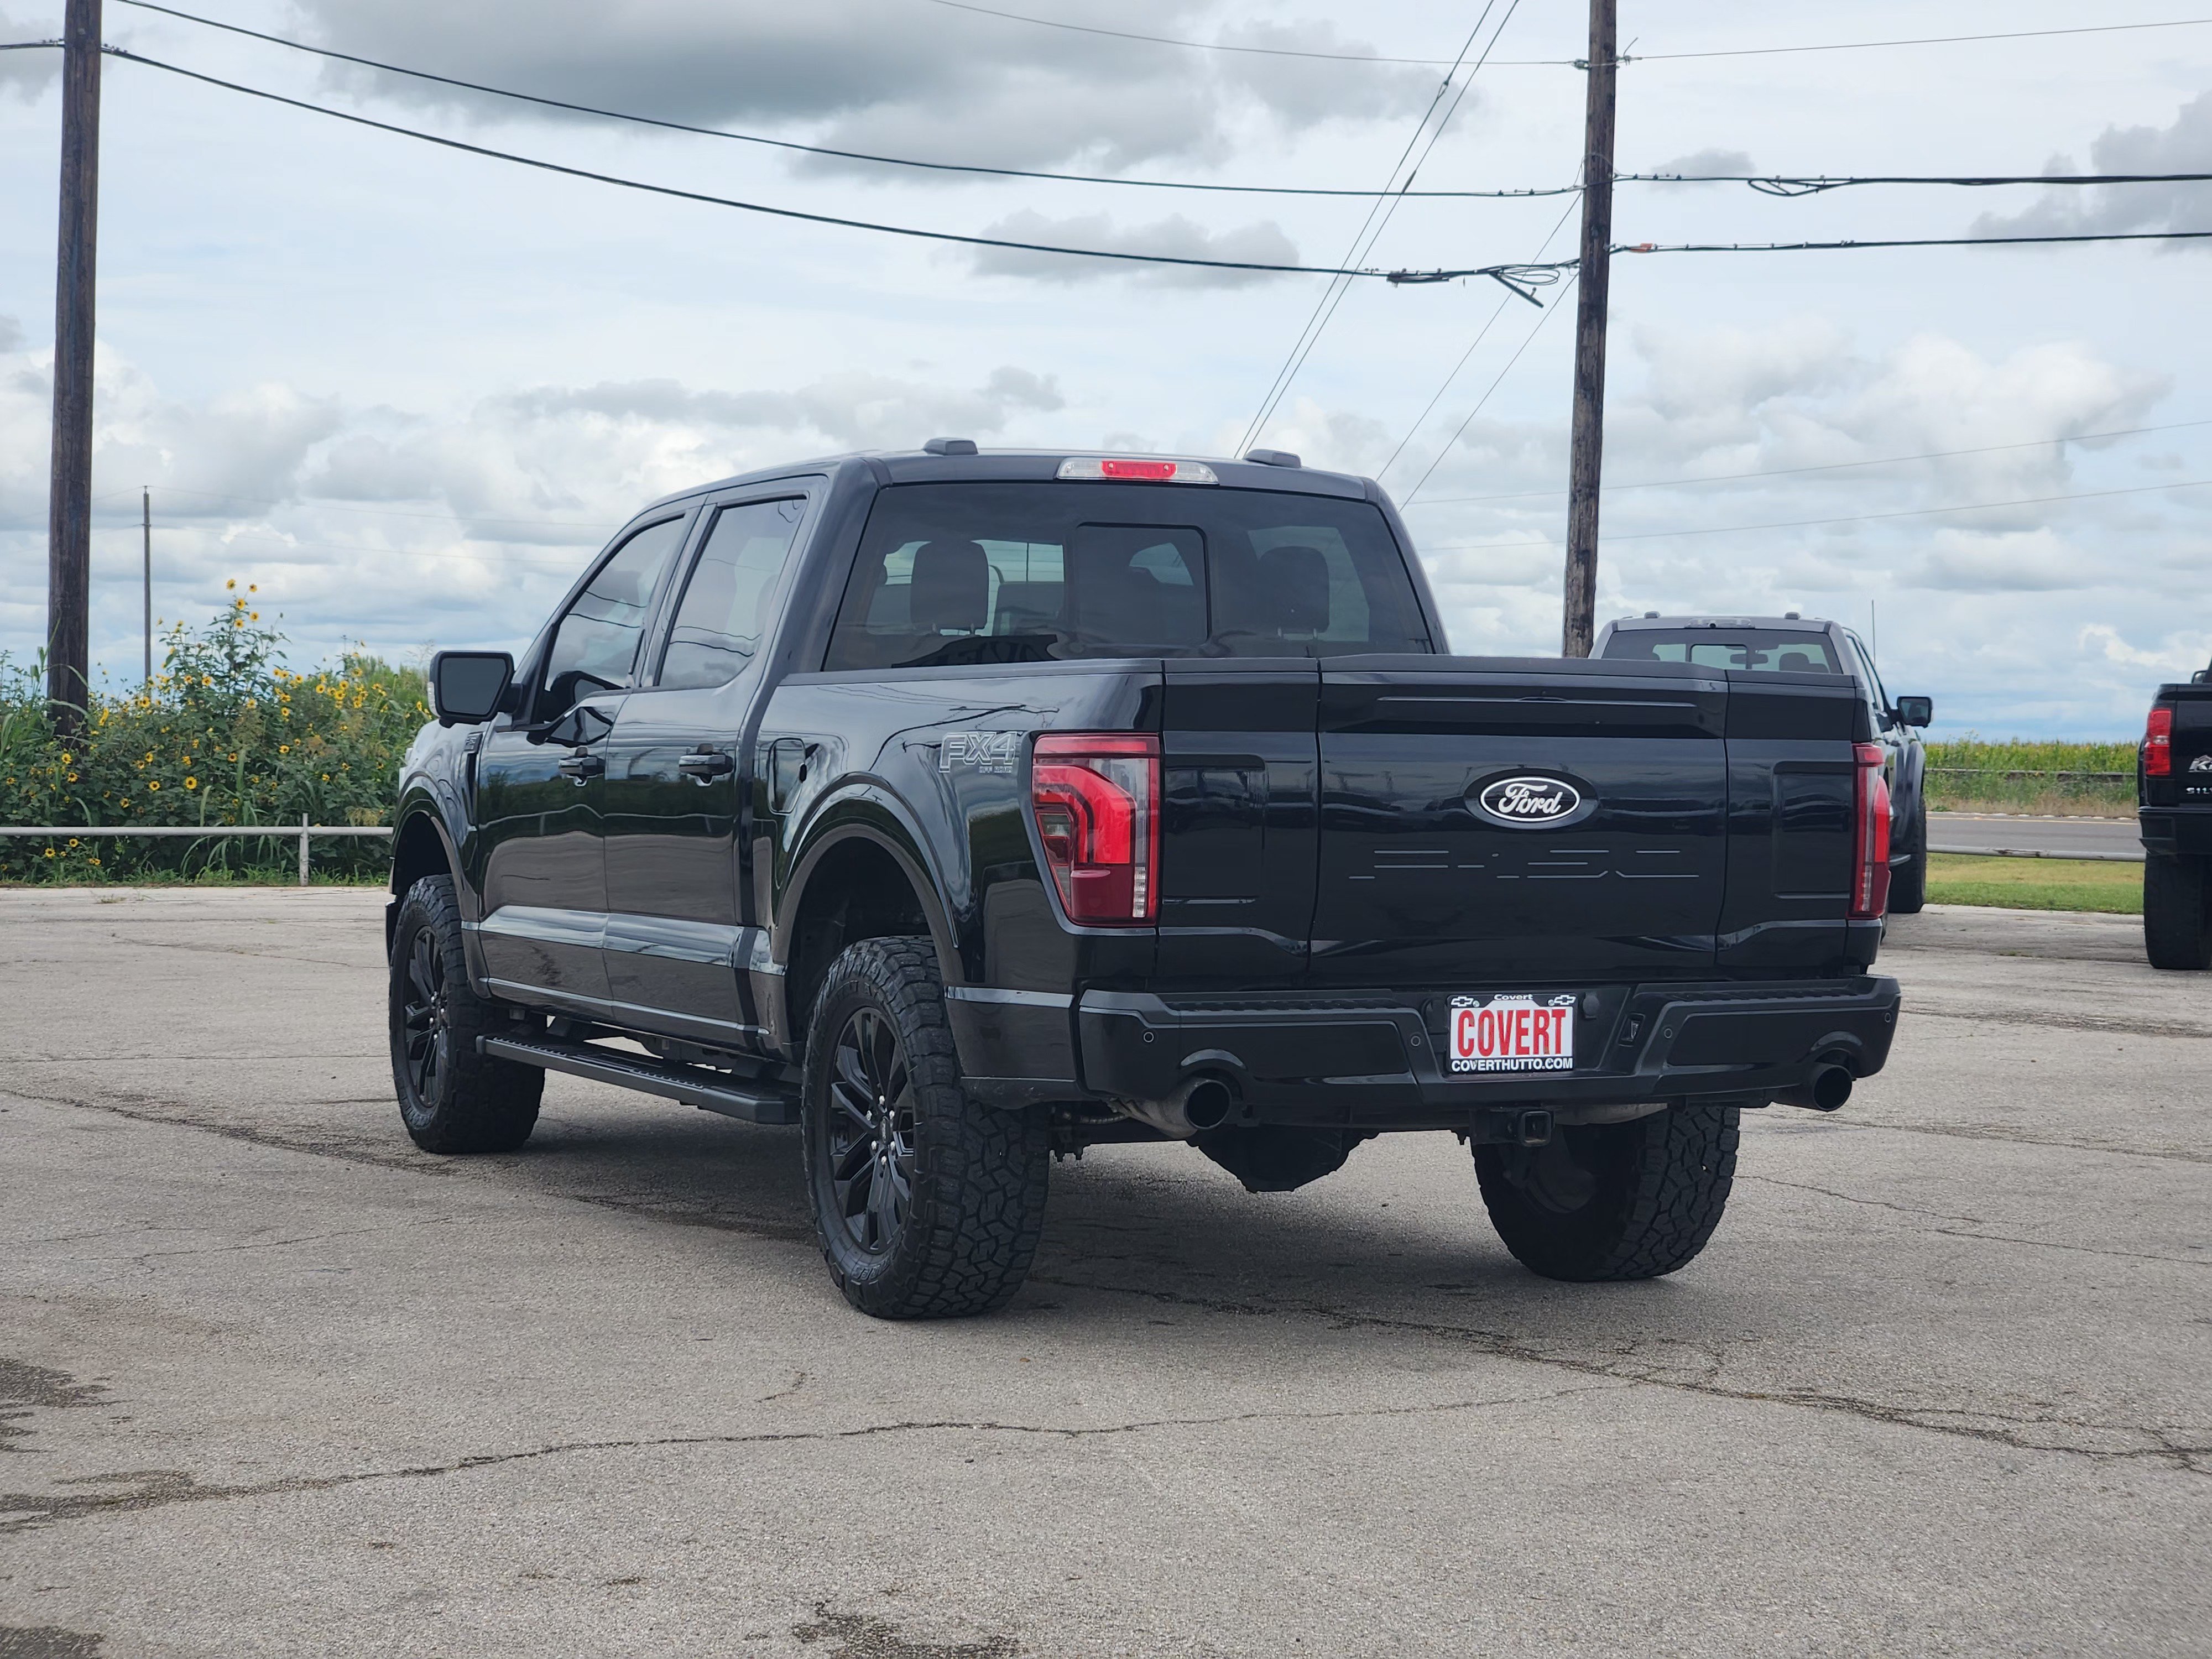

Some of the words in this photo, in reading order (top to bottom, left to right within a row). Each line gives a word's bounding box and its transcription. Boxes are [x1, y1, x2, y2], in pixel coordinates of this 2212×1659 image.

[939, 731, 1017, 773] FX4
[1498, 782, 1563, 815] Ford
[1457, 1009, 1567, 1057] COVERT
[1451, 1058, 1573, 1072] COVERTHUTTO.COM
